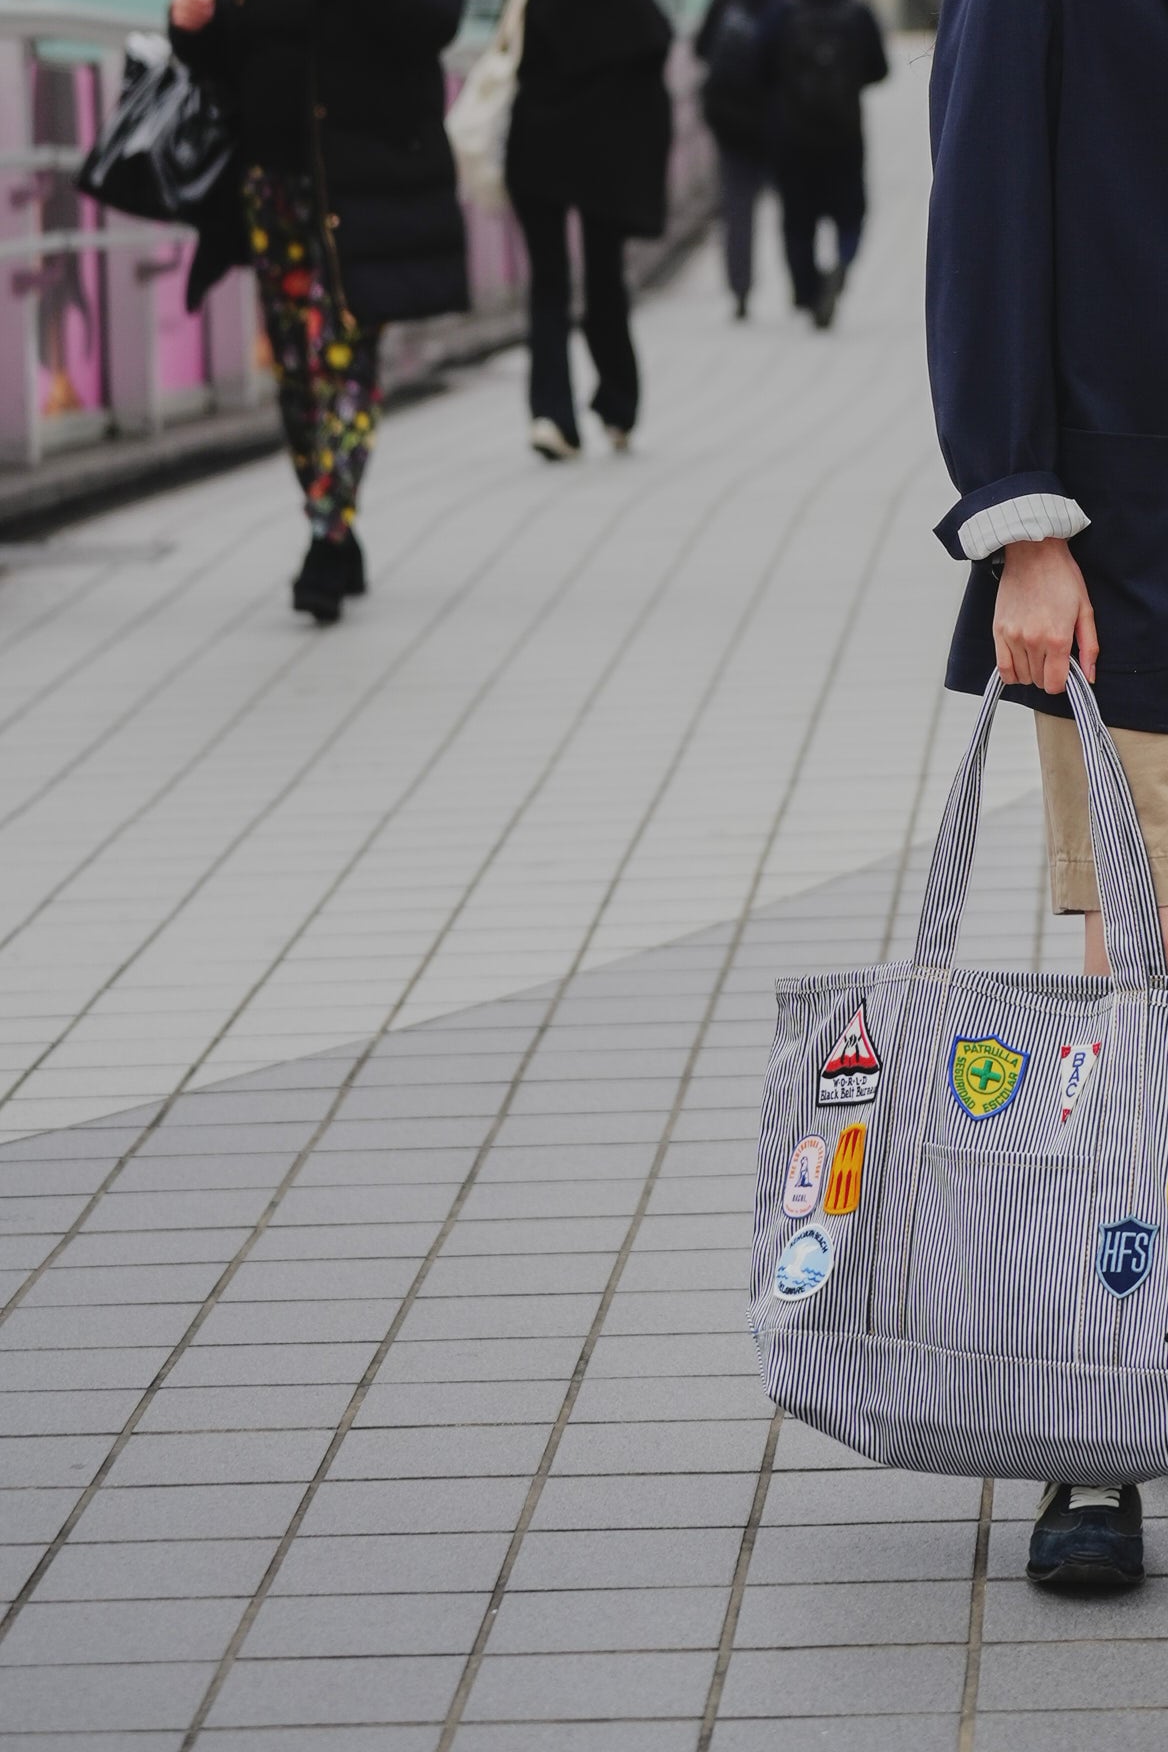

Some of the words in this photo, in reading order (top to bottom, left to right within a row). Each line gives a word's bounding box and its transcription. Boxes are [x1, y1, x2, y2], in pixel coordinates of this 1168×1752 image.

[964, 1043, 1018, 1068] PATRULLA
[1065, 1052, 1086, 1098] BAC
[820, 1088, 839, 1101] Black
[840, 1087, 855, 1100] Belt
[954, 1056, 976, 1109] SEGURIDAD
[983, 1072, 1018, 1113] ESCOLAR
[1102, 1231, 1149, 1273] HFS
